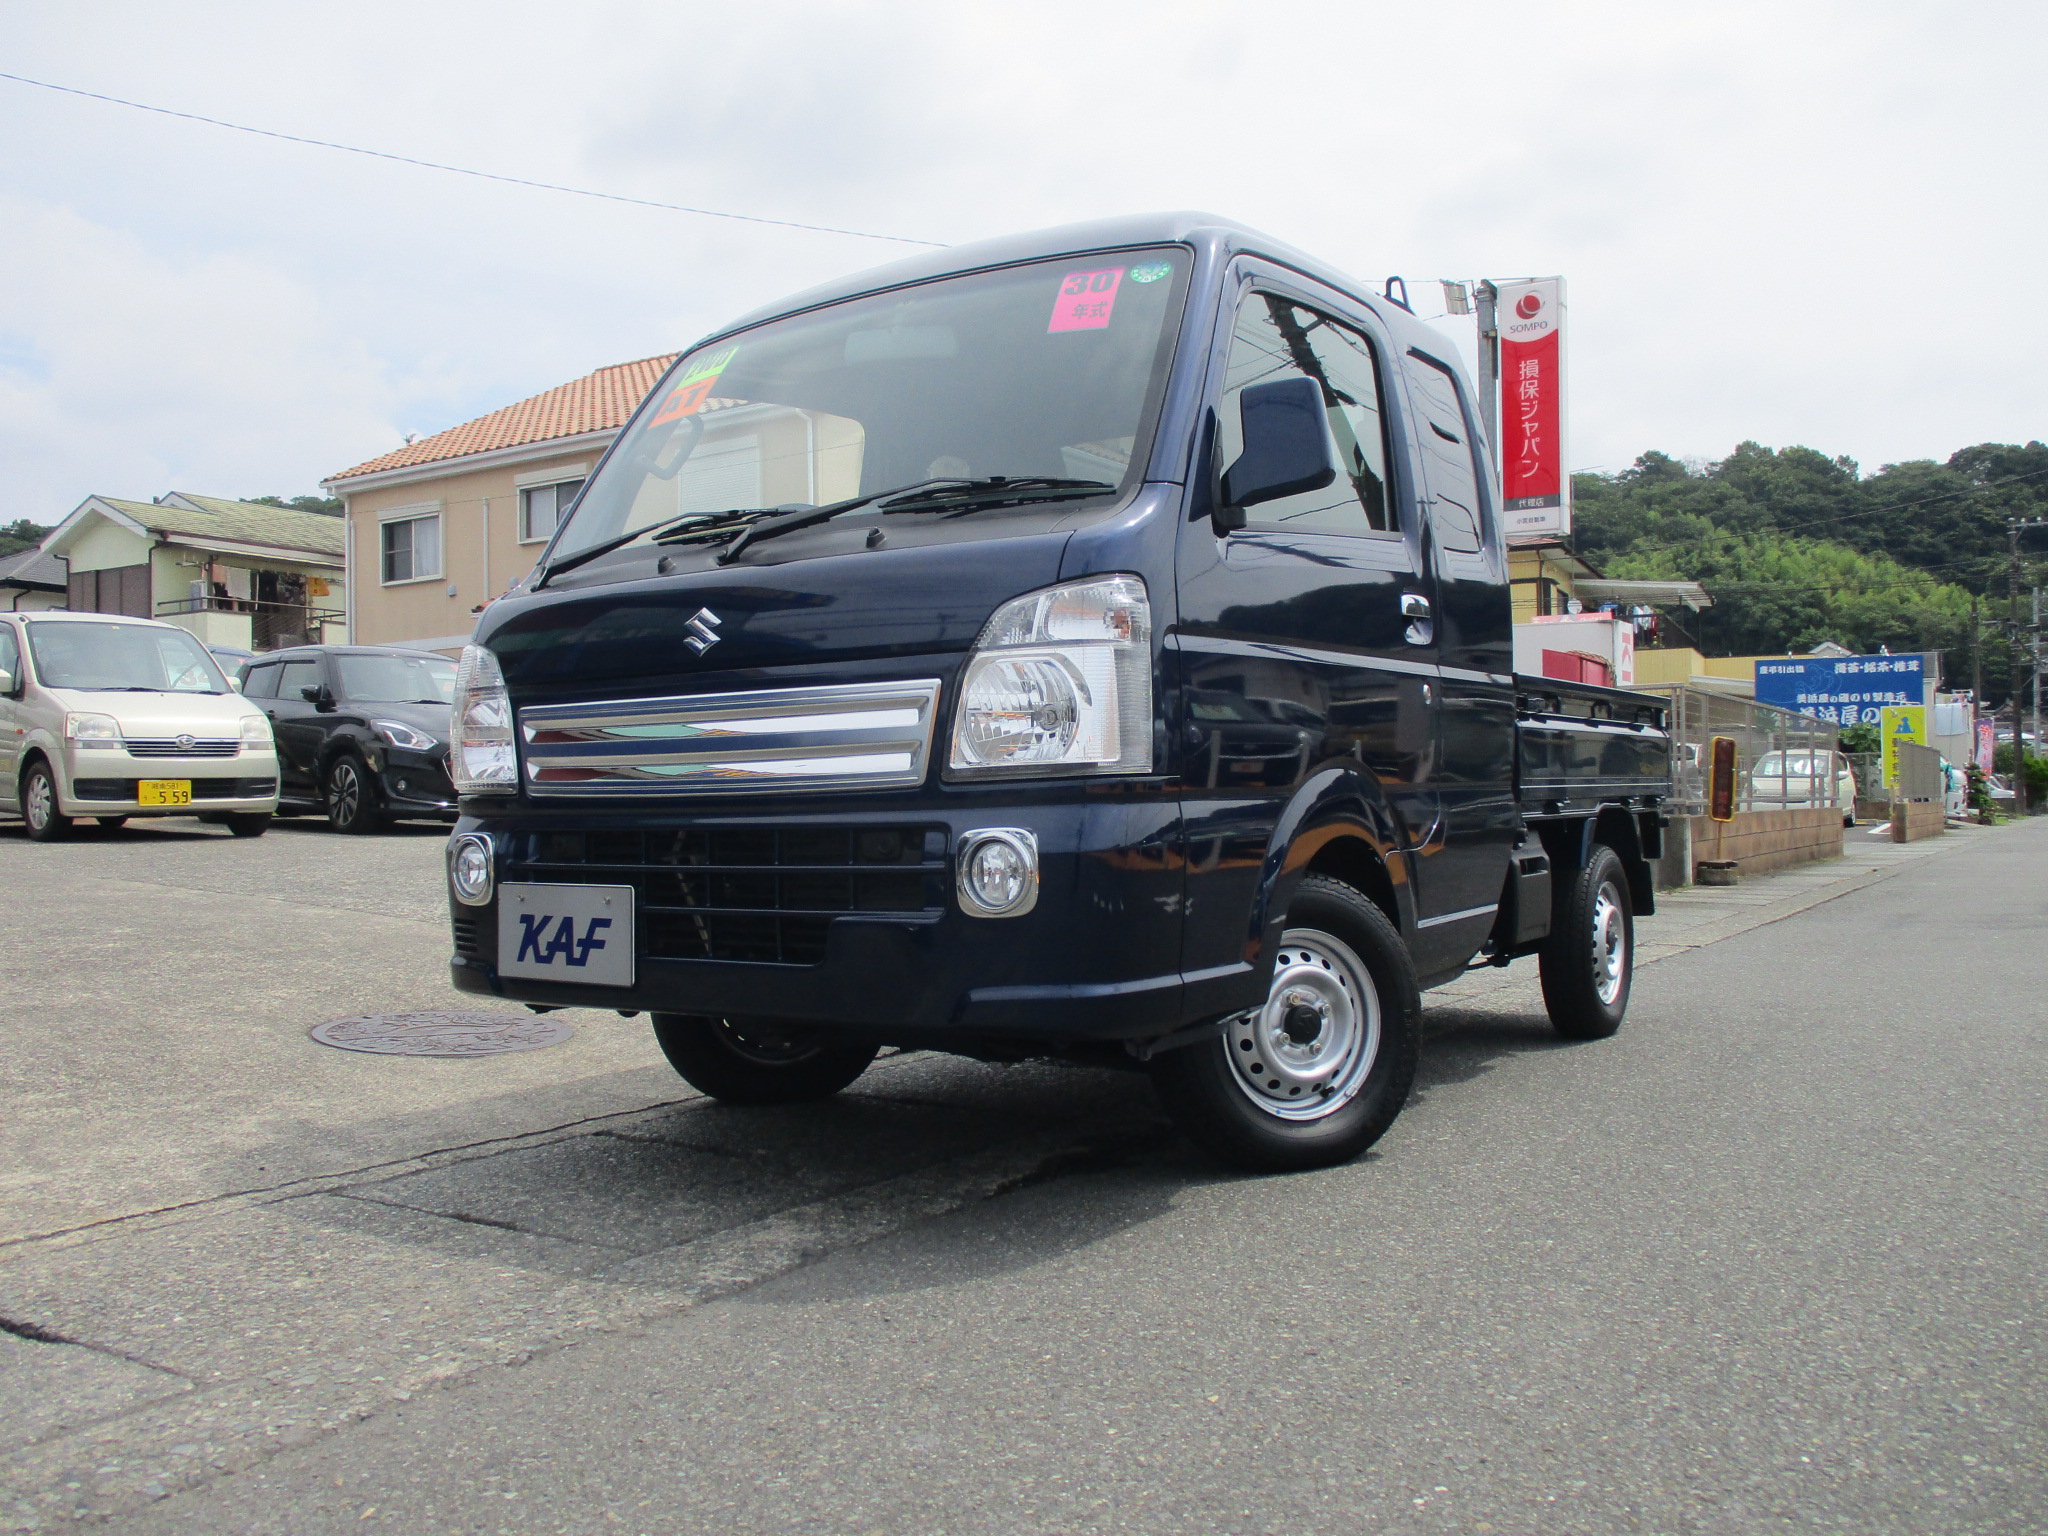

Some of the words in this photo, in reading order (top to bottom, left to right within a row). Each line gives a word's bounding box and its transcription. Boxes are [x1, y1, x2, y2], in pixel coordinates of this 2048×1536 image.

[1064, 272, 1116, 295] 30
[1071, 301, 1108, 319] 年式
[1510, 320, 1548, 334] SOMPO
[1519, 359, 1540, 478] 損保ジャパン
[1519, 497, 1545, 508] 代理店
[516, 913, 613, 967] KAF
